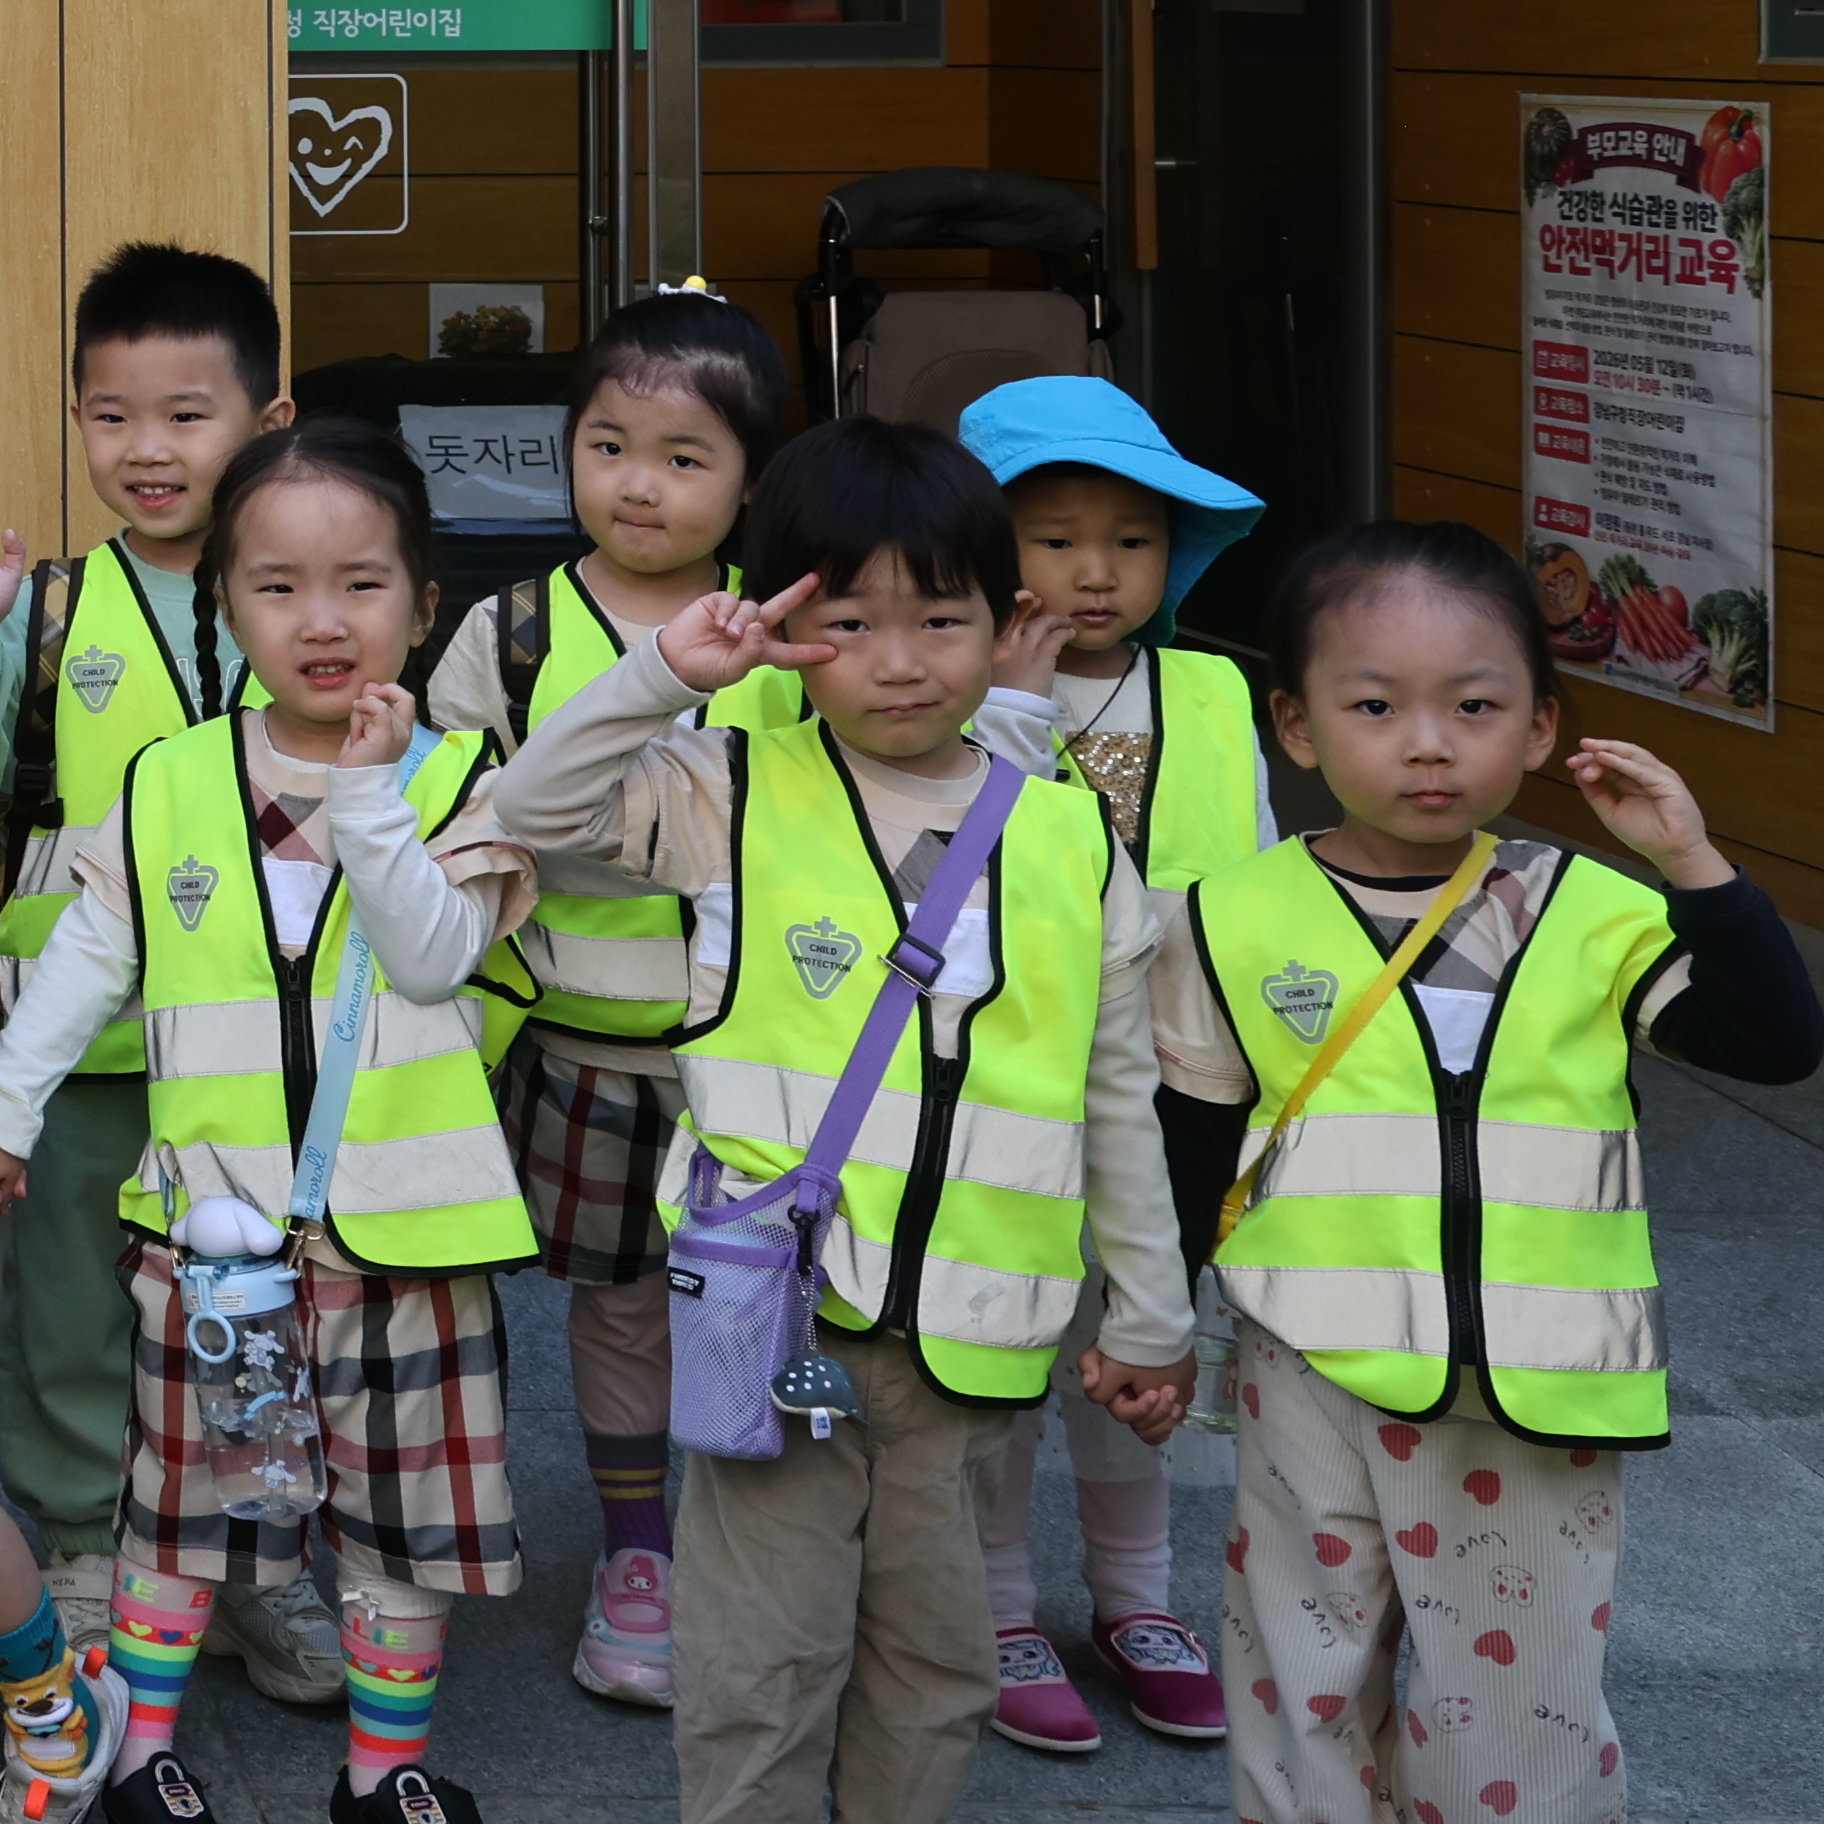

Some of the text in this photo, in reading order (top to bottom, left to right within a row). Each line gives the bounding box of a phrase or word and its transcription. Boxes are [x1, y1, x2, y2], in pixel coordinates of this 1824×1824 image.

[313, 8, 462, 38] 직장어린이집
[1586, 129, 1687, 167] 부모교육 안내
[1557, 190, 1718, 233] 건강한 식습관을 위한
[1539, 224, 1740, 295] 안전먹거리 교육
[425, 434, 559, 474] 돗자리
[72, 679, 118, 689] PROTECTION
[82, 669, 105, 677] CHILD
[792, 955, 851, 972] PROTECTION
[809, 943, 838, 956] CHILD
[333, 931, 371, 1044] Cinnamoroll
[1285, 988, 1315, 999] CHILD
[1273, 1001, 1333, 1015] PROTECTION
[304, 1145, 328, 1221] amoroll
[1455, 1531, 1507, 1559] love
[52, 1578, 76, 1587] NEPA
[1301, 1596, 1337, 1649] love
[1416, 1594, 1459, 1626] love
[1222, 1604, 1254, 1654] love
[1534, 1703, 1589, 1744] love
